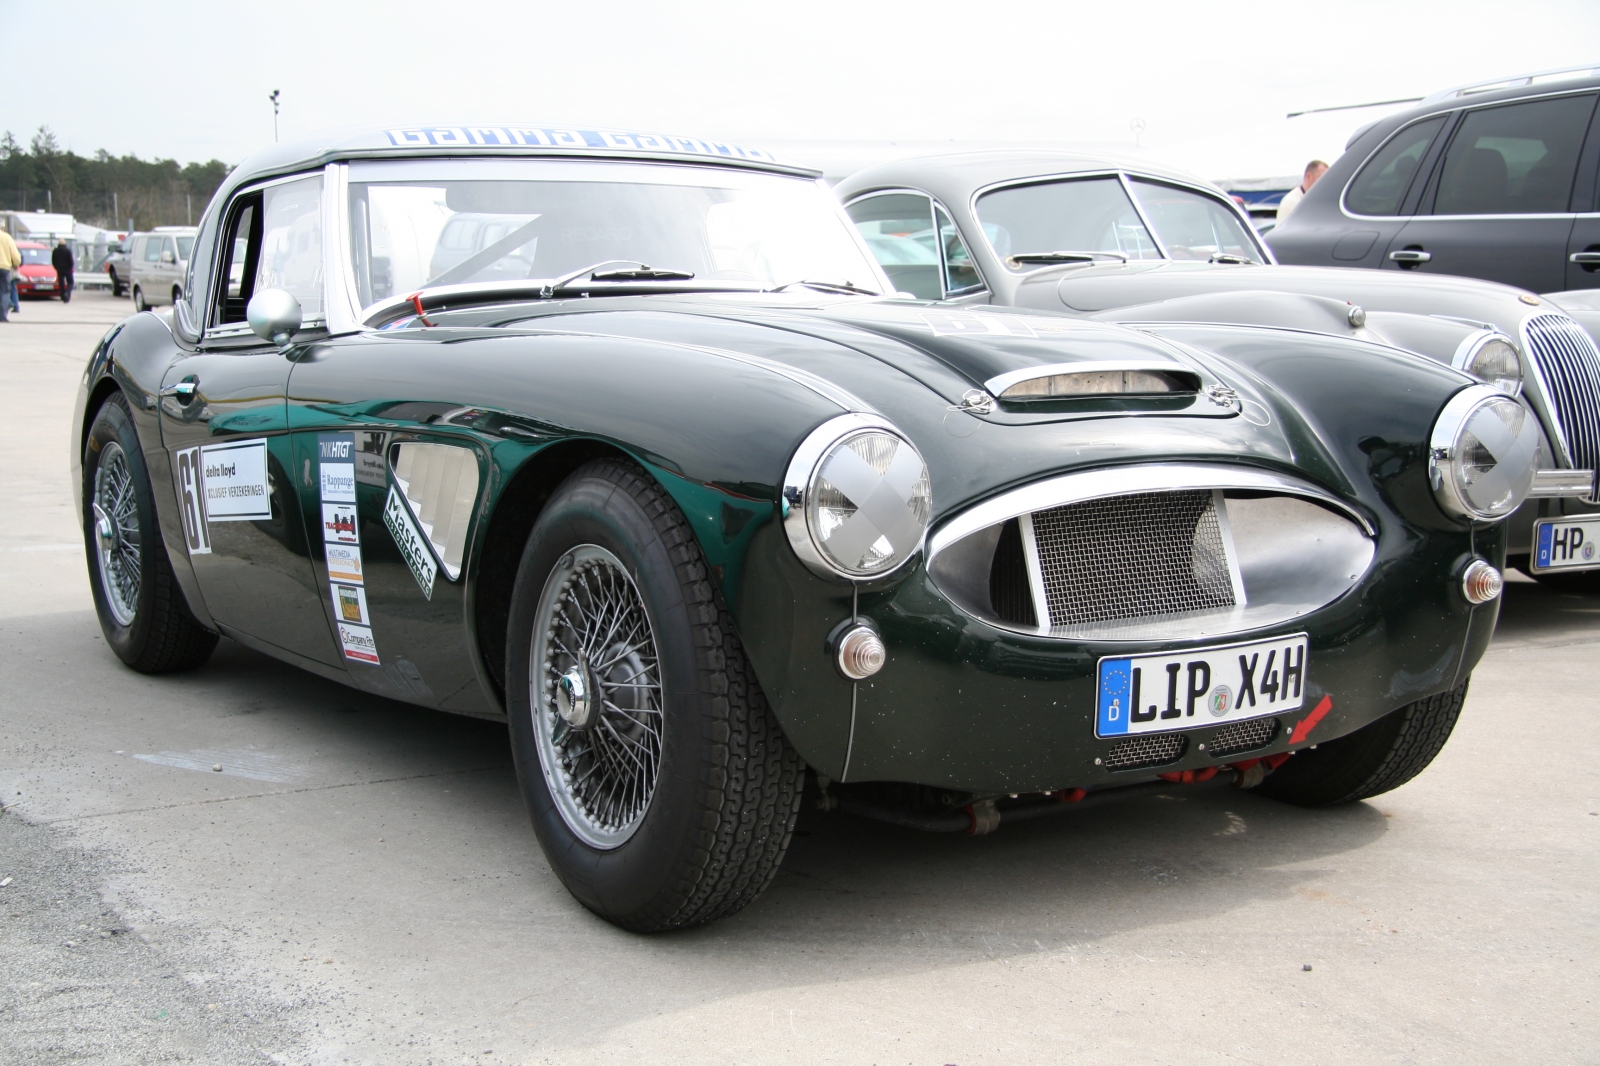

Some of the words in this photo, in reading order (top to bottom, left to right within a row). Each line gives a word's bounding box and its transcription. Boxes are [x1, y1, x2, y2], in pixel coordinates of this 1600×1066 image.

[561, 226, 632, 242] RECARO
[206, 464, 220, 478] delta
[221, 462, 235, 478] lloyd
[327, 474, 353, 489] Rappange
[178, 448, 210, 550] 61
[228, 484, 265, 498] VERZEKERINGEN
[385, 514, 409, 557] HISTORIC
[409, 558, 430, 595] RACING
[388, 493, 433, 584] Masters
[1552, 527, 1583, 560] HP
[1131, 660, 1211, 723] LIP
[1235, 644, 1304, 710] X4H
